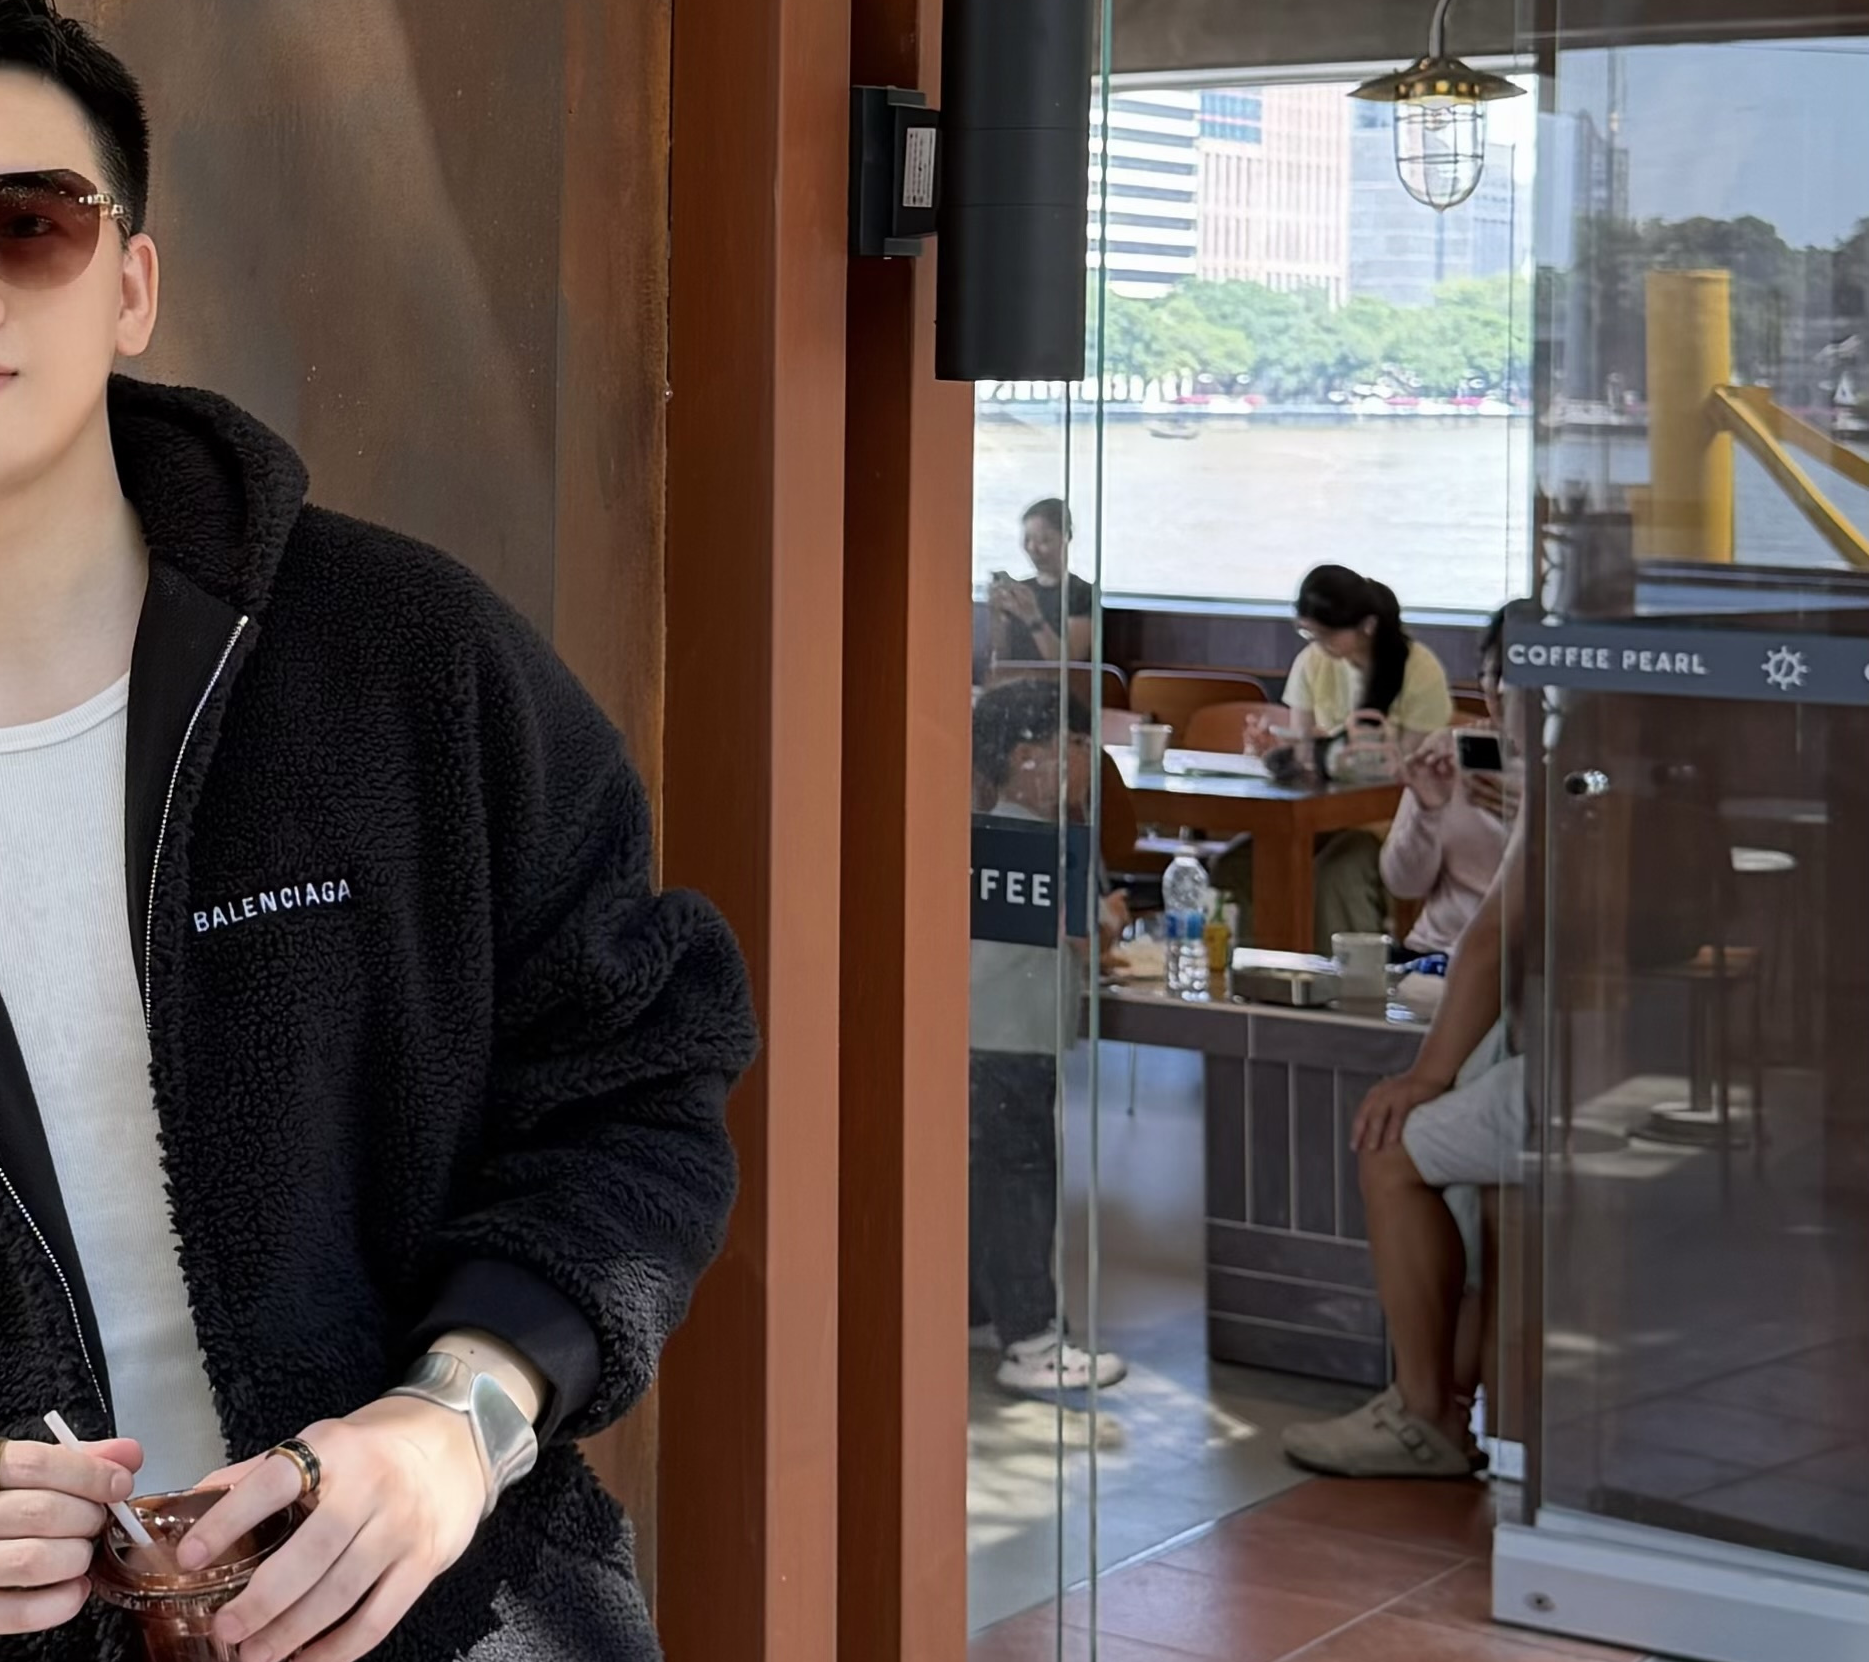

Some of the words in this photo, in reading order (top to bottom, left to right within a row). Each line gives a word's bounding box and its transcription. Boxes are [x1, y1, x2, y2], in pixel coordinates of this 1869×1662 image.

[1507, 643, 1610, 670] COFFEE
[1621, 649, 1708, 675] PEARL
[193, 878, 352, 932] BALENCIAGA
[970, 868, 1051, 907] FEE
